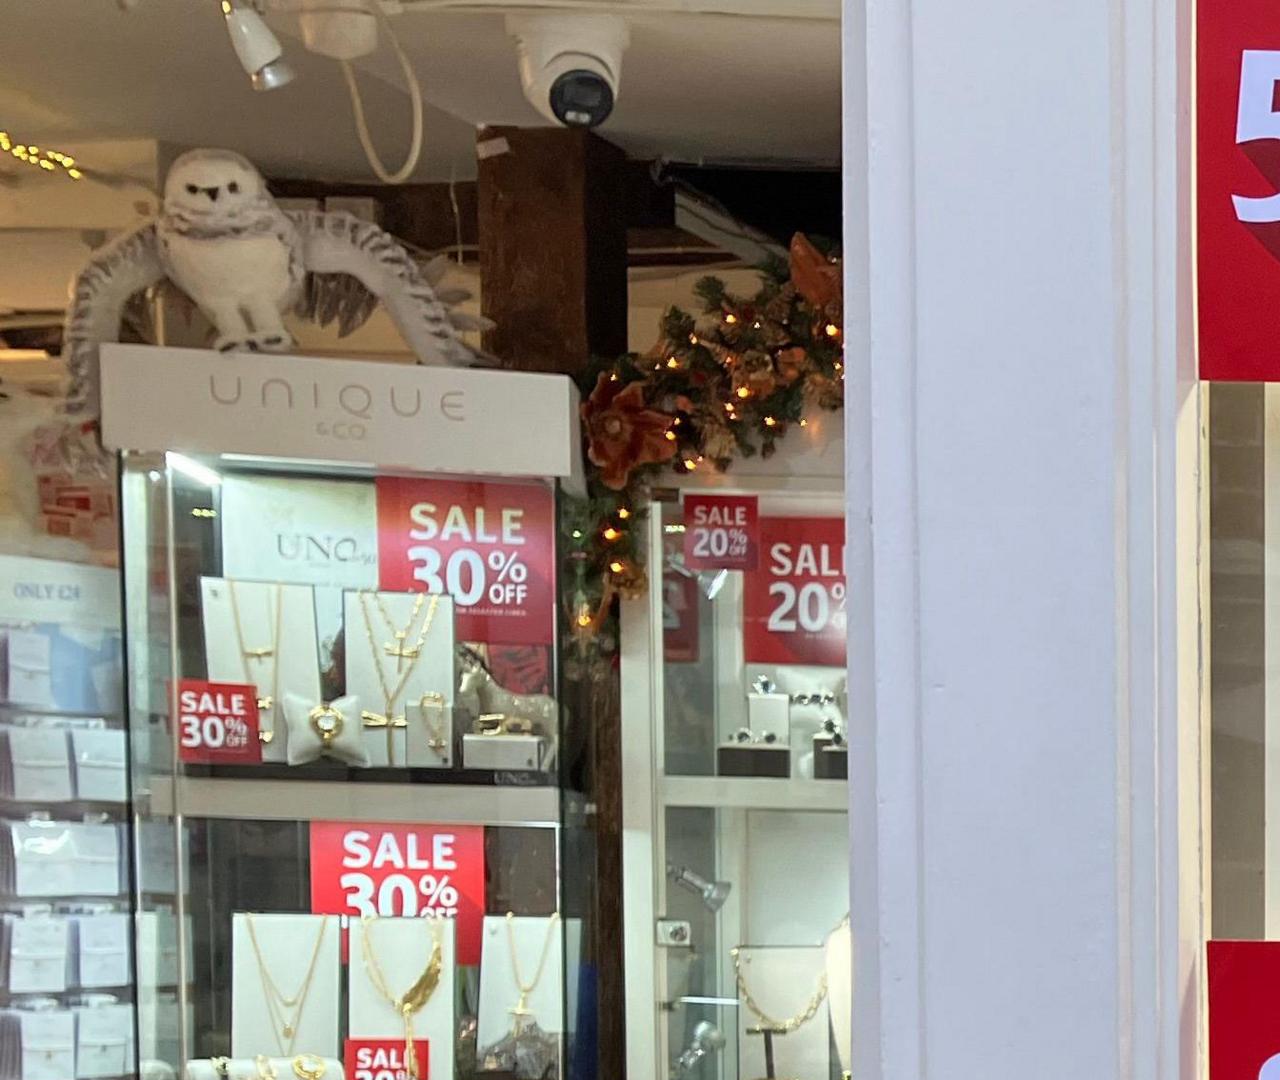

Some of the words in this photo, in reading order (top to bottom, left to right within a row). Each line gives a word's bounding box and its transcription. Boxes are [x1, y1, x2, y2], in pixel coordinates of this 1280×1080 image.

[209, 375, 465, 420] UNIQUE
[409, 502, 526, 546] SALE
[693, 505, 747, 527] SALE
[692, 527, 748, 557] 20%
[769, 542, 846, 577] SAL
[407, 545, 528, 606] 30%
[488, 584, 528, 605] OFF
[180, 689, 247, 716] SALE
[180, 714, 248, 749] 30%
[342, 830, 458, 871] SALE
[356, 1046, 408, 1070] SAL
